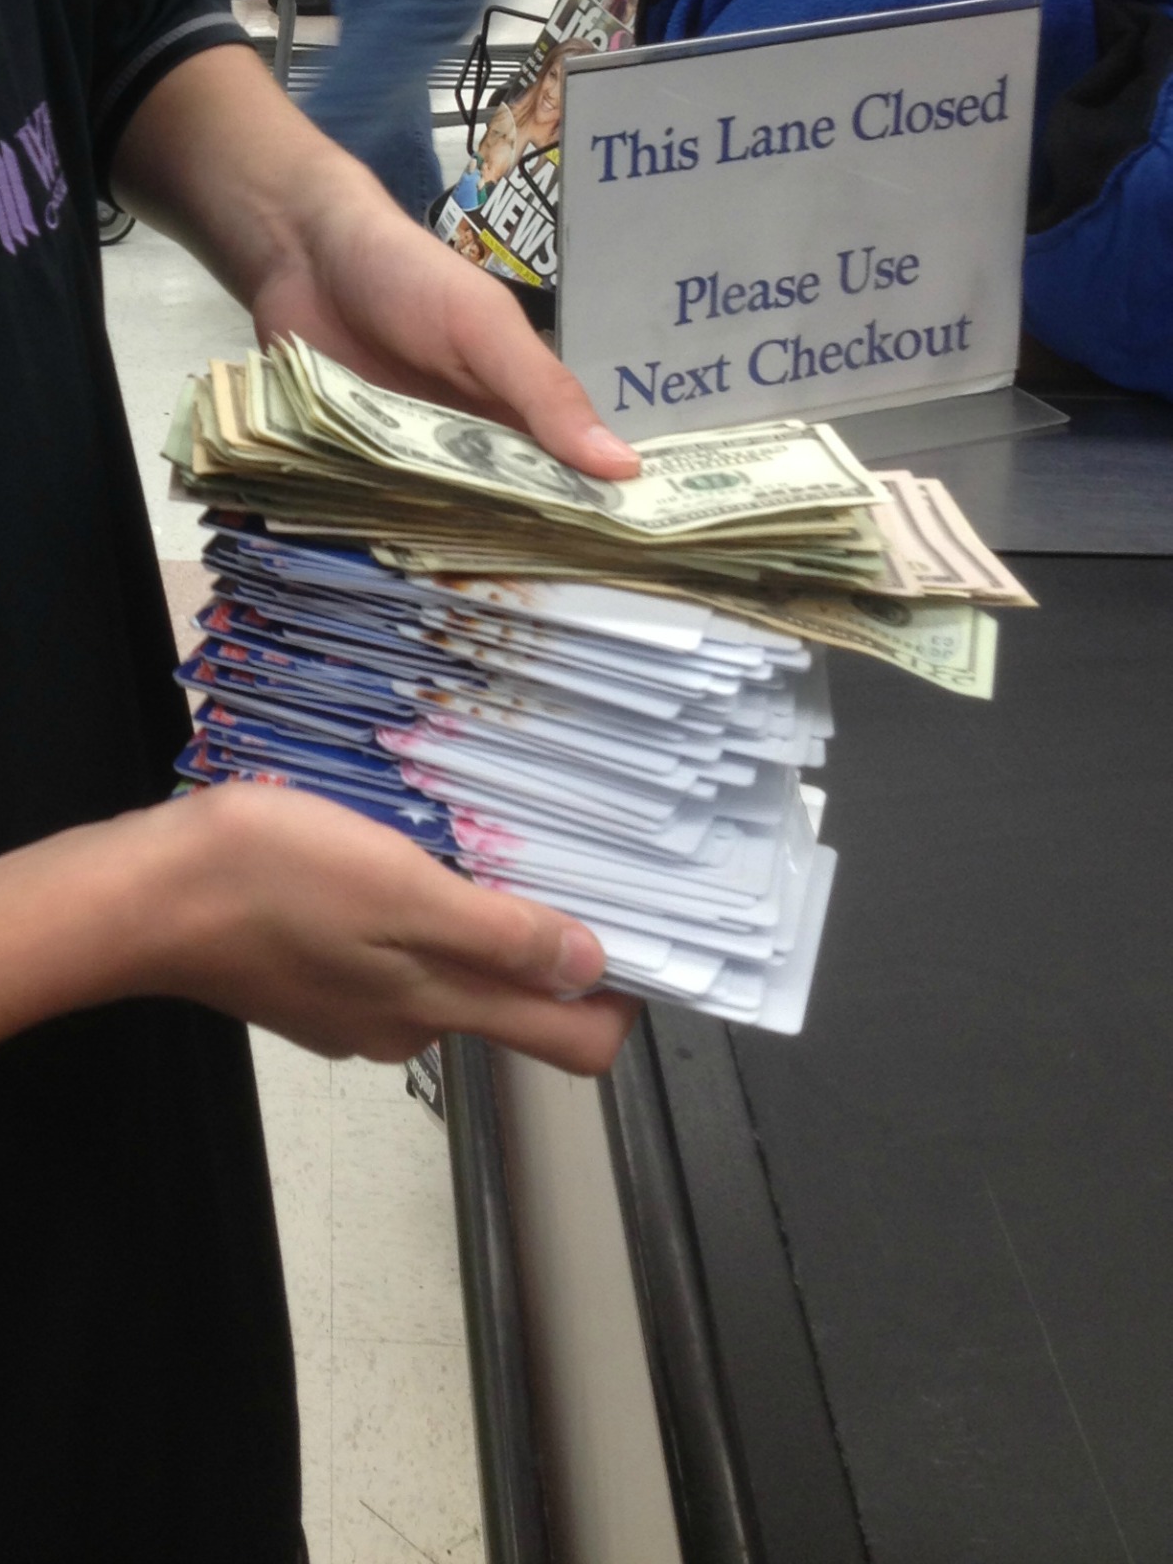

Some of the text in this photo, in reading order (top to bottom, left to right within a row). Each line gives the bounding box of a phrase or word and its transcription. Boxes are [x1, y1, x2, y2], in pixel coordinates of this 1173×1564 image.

[591, 74, 1009, 183] This Lane Closed
[673, 245, 921, 327] Please Use
[613, 312, 974, 412] Next Checkout
